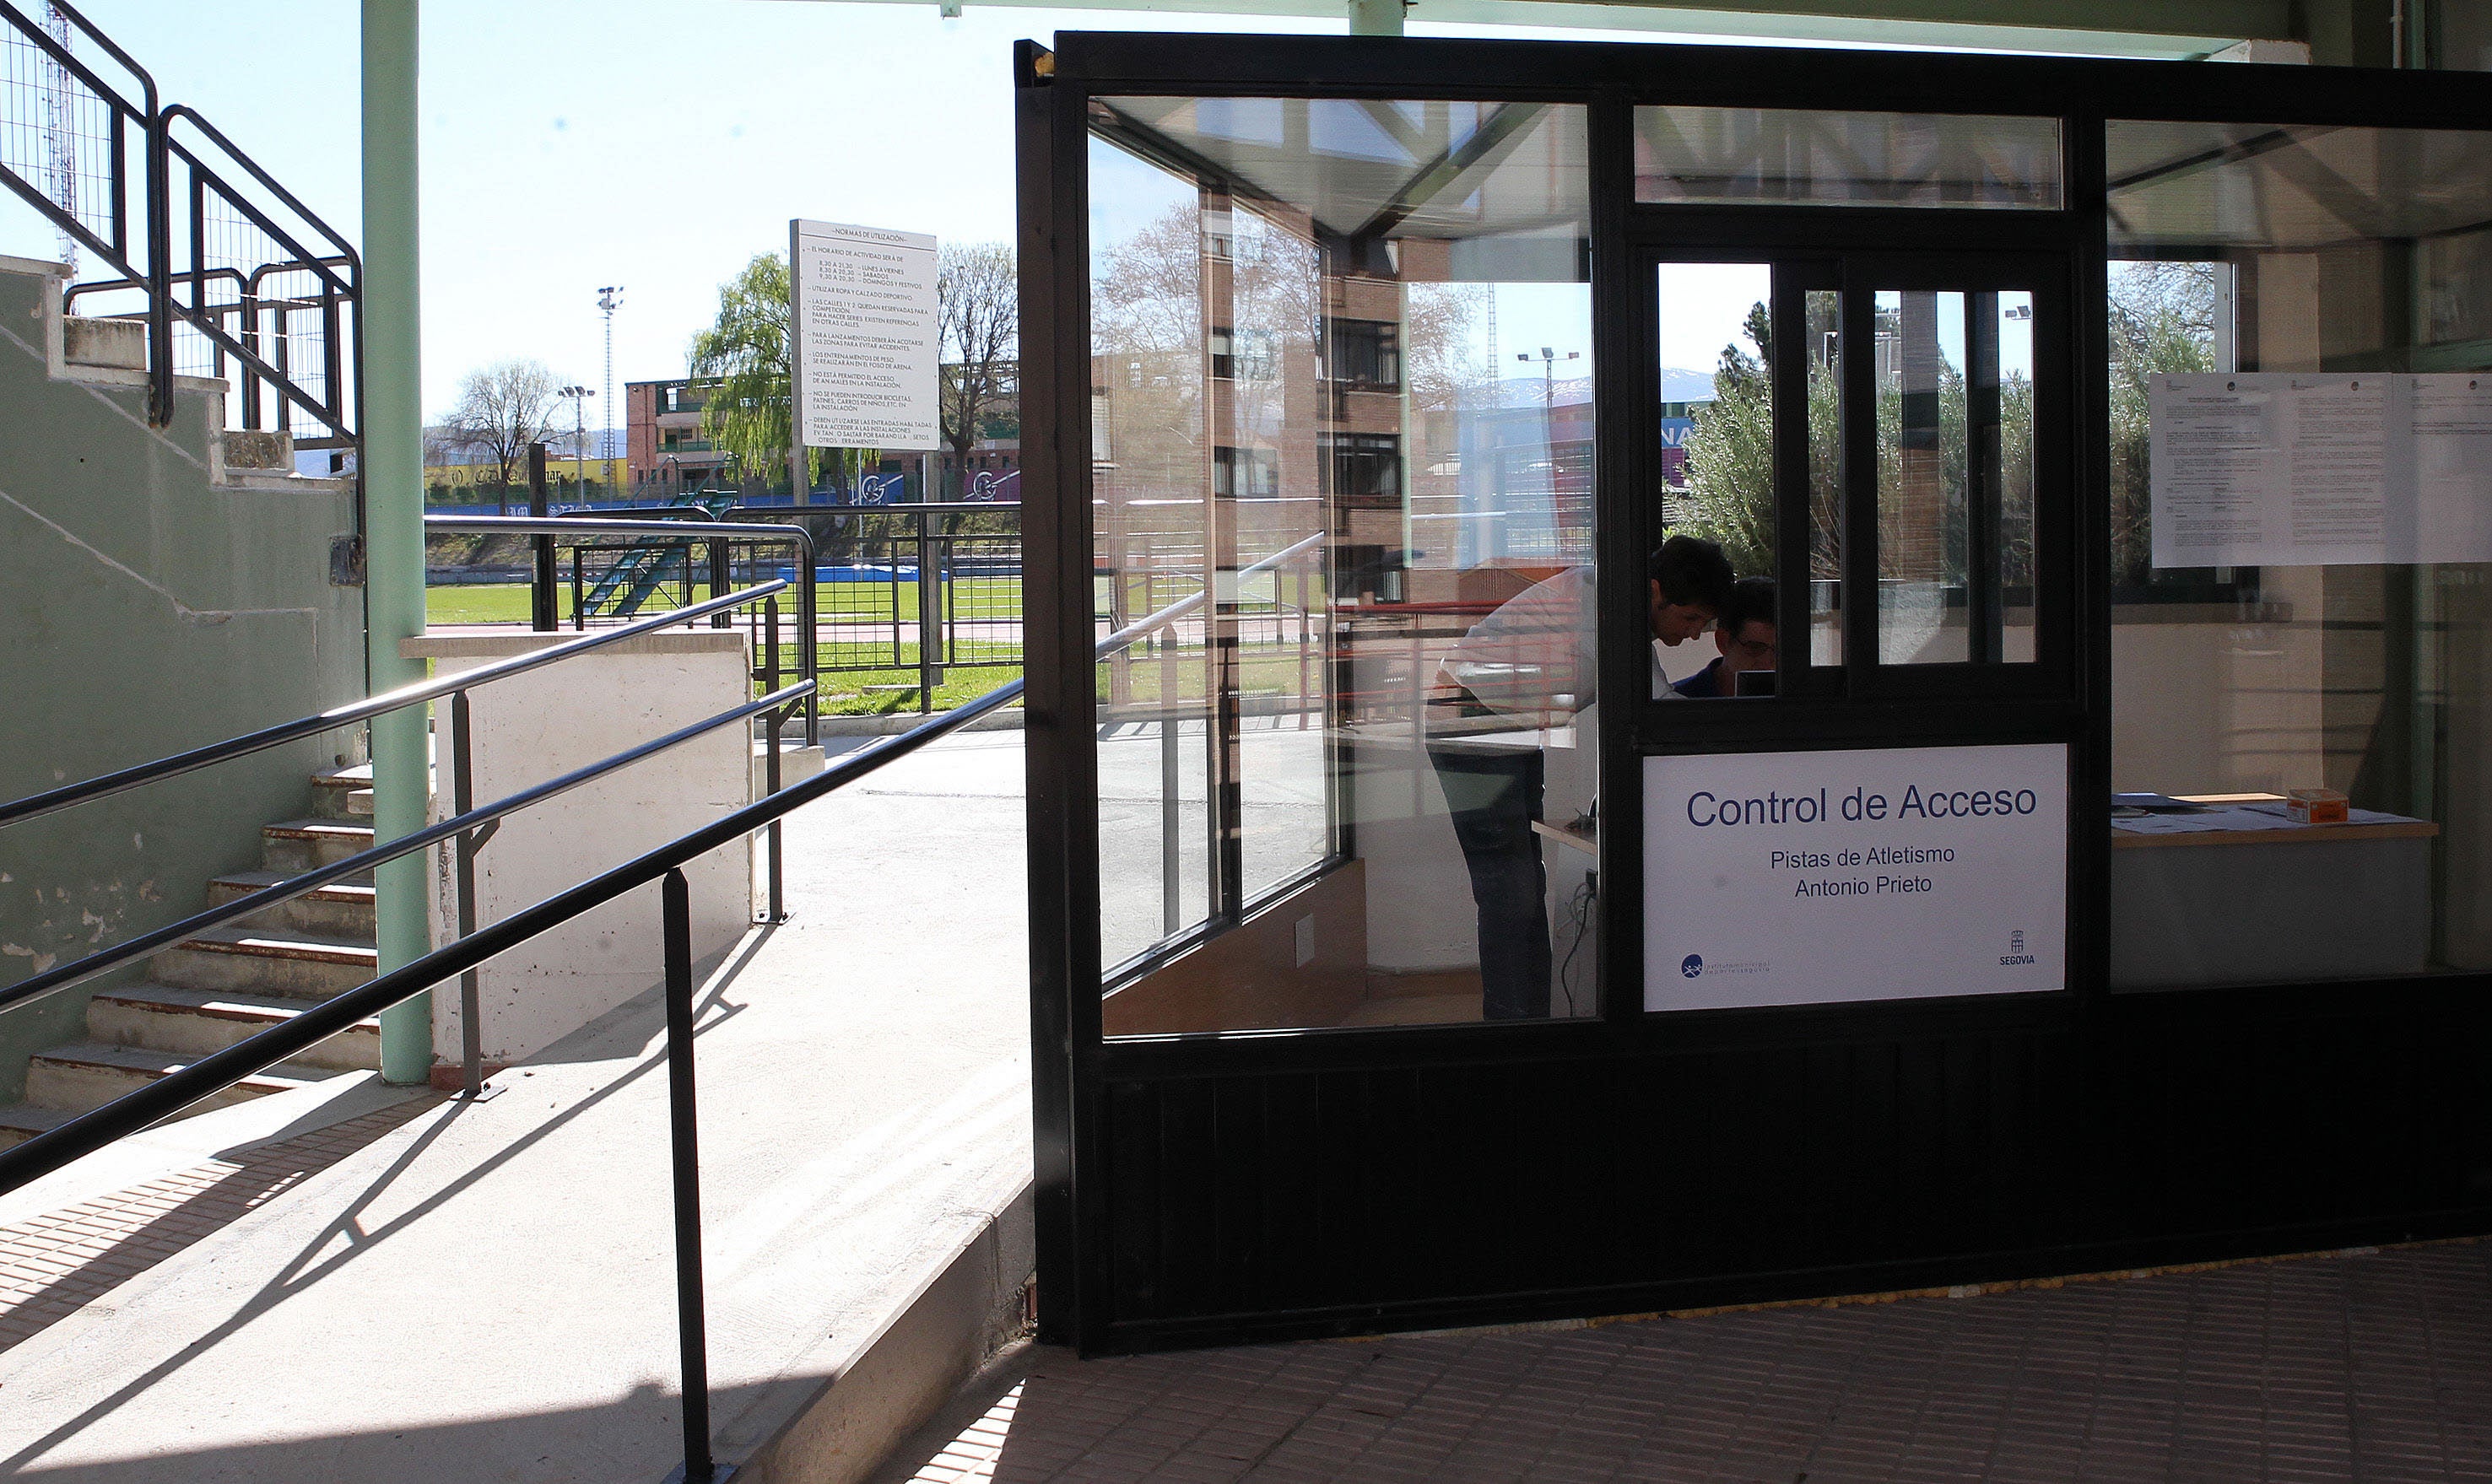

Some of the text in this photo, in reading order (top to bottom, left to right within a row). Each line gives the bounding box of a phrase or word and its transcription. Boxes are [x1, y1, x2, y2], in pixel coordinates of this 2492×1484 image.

[1687, 785, 2037, 827] Control de Acceso
[1771, 846, 1955, 870] Pistas de Atletismo
[1794, 874, 1933, 898] Antonio Prieto
[2000, 955, 2035, 965] SEGOVIA
